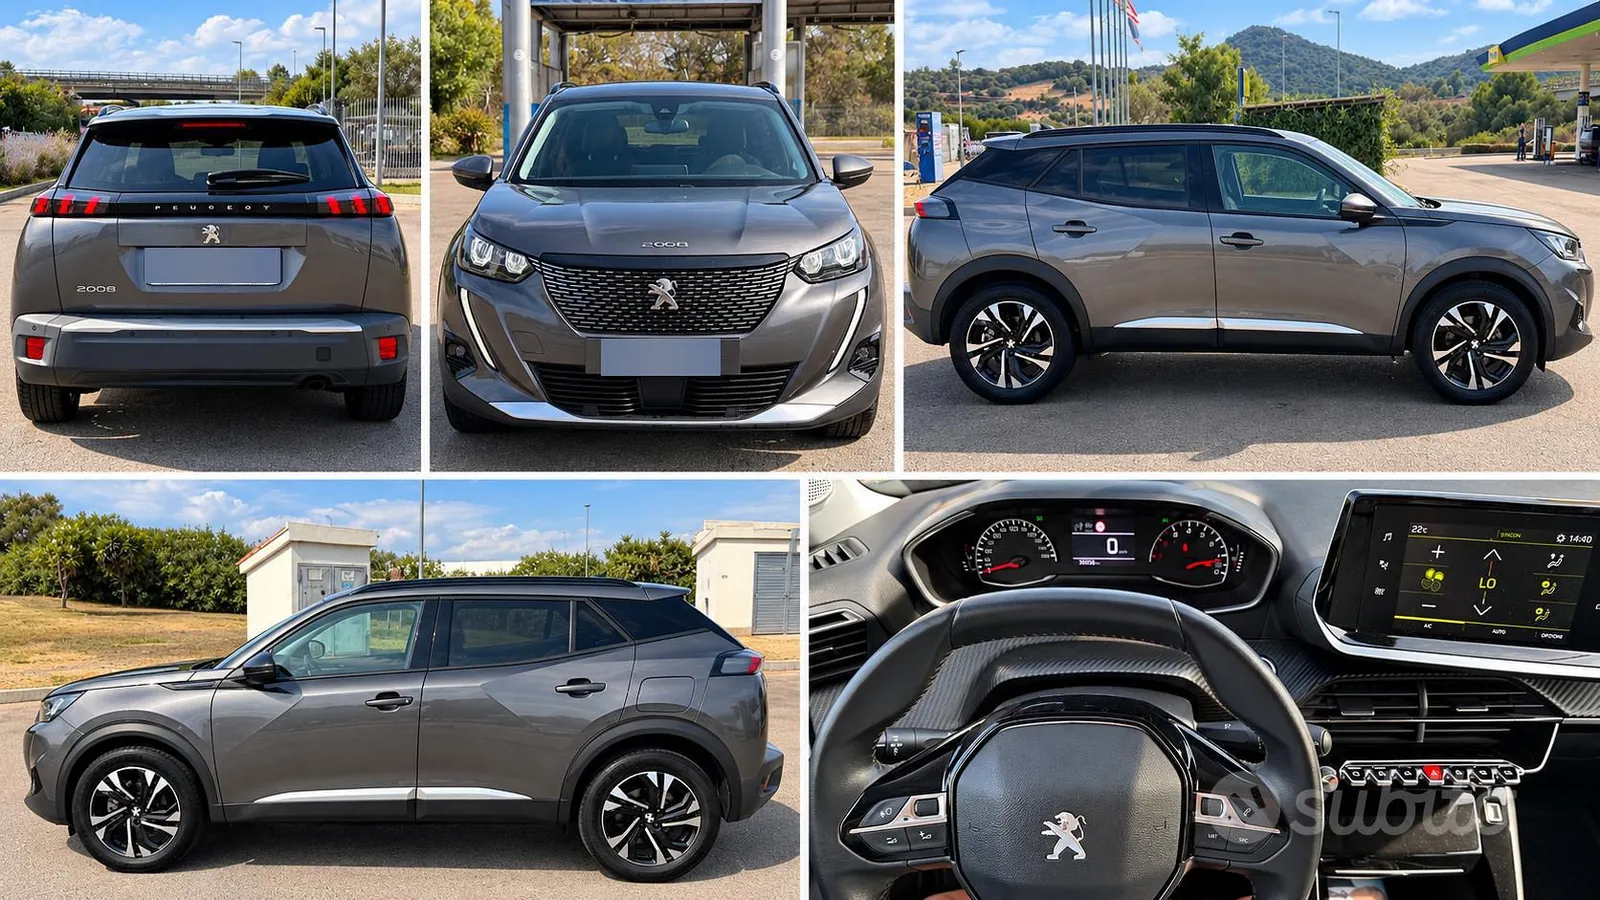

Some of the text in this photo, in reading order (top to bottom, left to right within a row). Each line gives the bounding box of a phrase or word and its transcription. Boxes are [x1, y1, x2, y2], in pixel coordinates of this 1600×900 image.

[641, 241, 689, 249] 2008
[76, 285, 116, 293] 2008
[1569, 535, 1593, 544] 14:40
[1106, 537, 1118, 555] 0
[1479, 577, 1497, 589] LO
